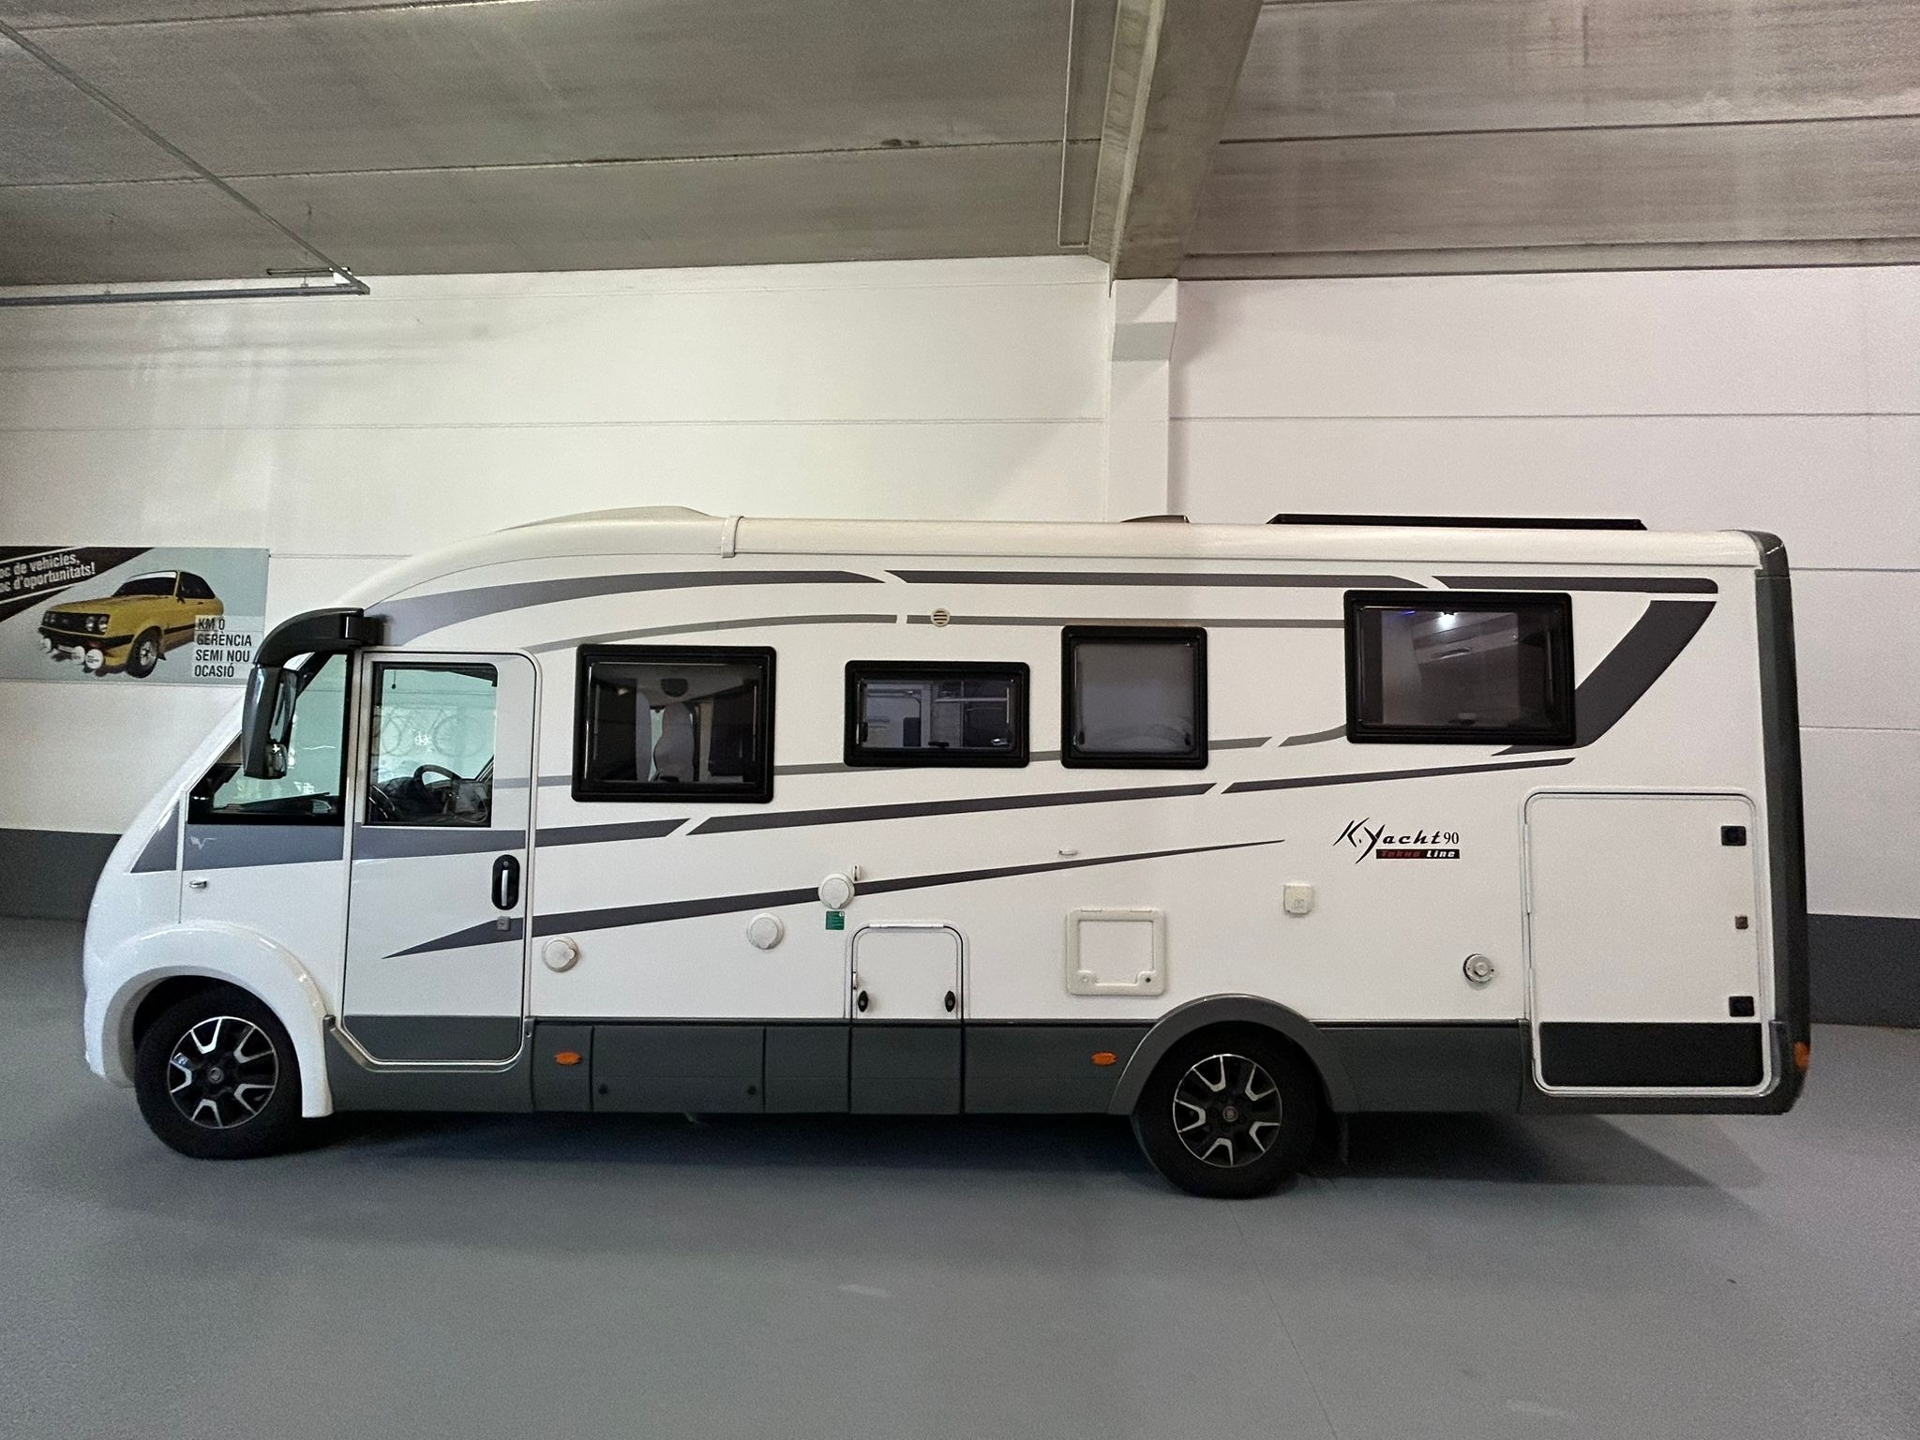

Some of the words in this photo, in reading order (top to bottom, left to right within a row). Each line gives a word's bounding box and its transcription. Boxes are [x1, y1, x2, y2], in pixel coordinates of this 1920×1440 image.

[13, 562, 27, 575] de
[29, 553, 80, 572] vehicles,
[13, 561, 96, 590] d'oportunitats!
[198, 618, 215, 630] KM
[196, 631, 252, 647] GERÈNCIA
[195, 649, 223, 662] SEMI
[226, 650, 250, 663] NOU
[194, 662, 235, 678] OCASIÓ
[1443, 832, 1459, 844] 90
[1426, 849, 1456, 858] Line
